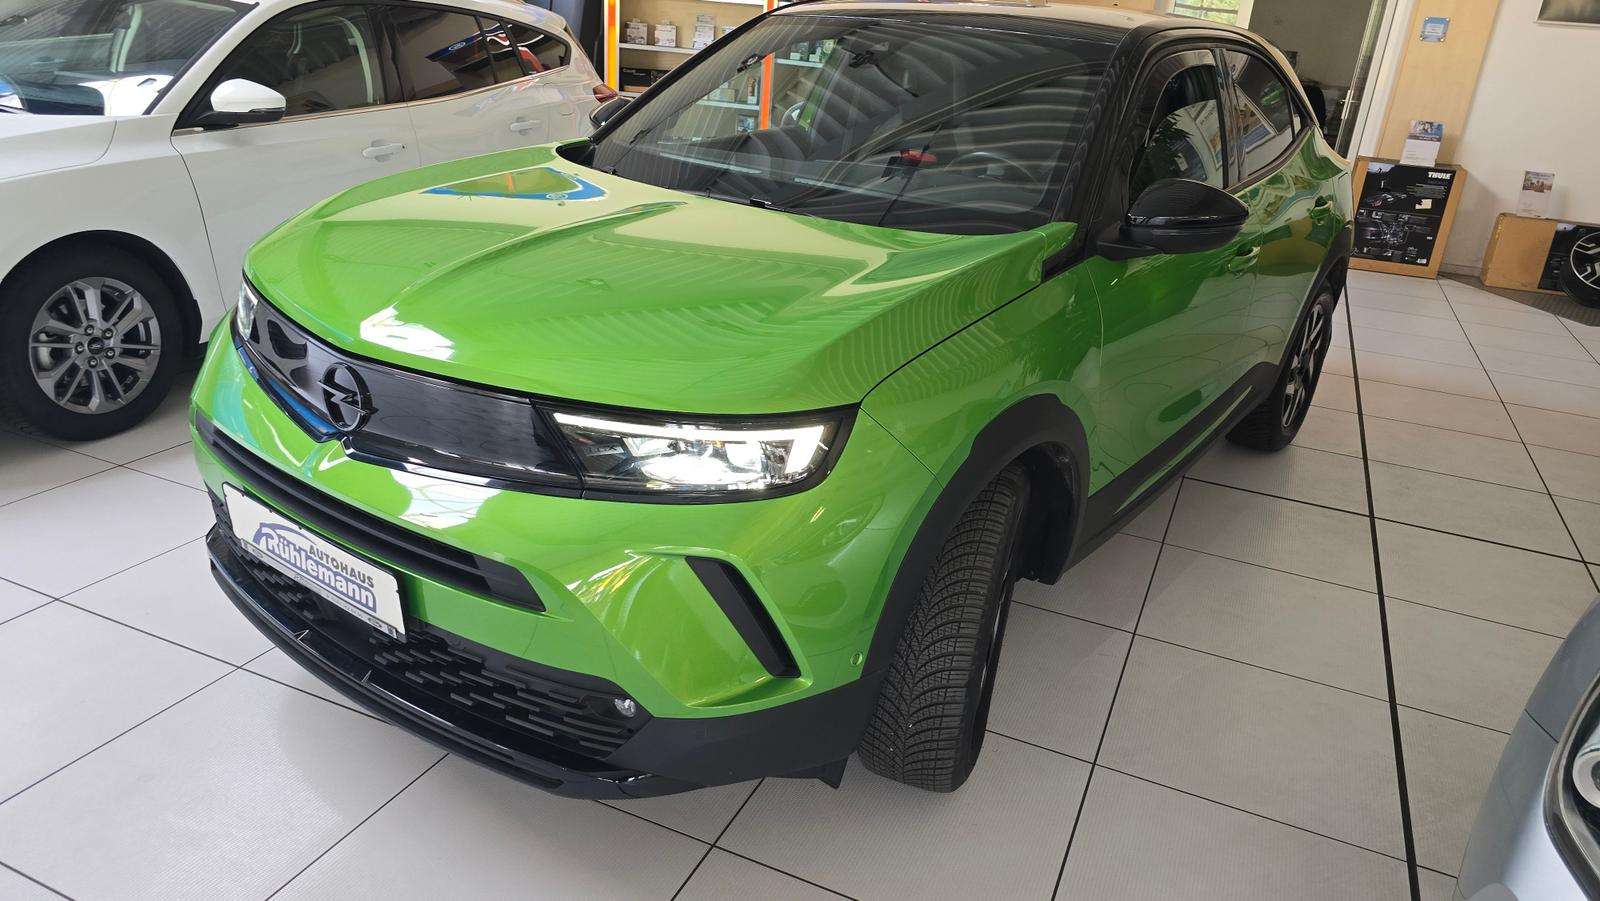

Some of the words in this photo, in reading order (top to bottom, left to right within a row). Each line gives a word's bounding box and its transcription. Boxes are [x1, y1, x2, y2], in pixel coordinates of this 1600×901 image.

[1427, 171, 1452, 180] THULE
[259, 527, 375, 609] Rühlemann
[308, 545, 375, 589] AUTOHAUS
